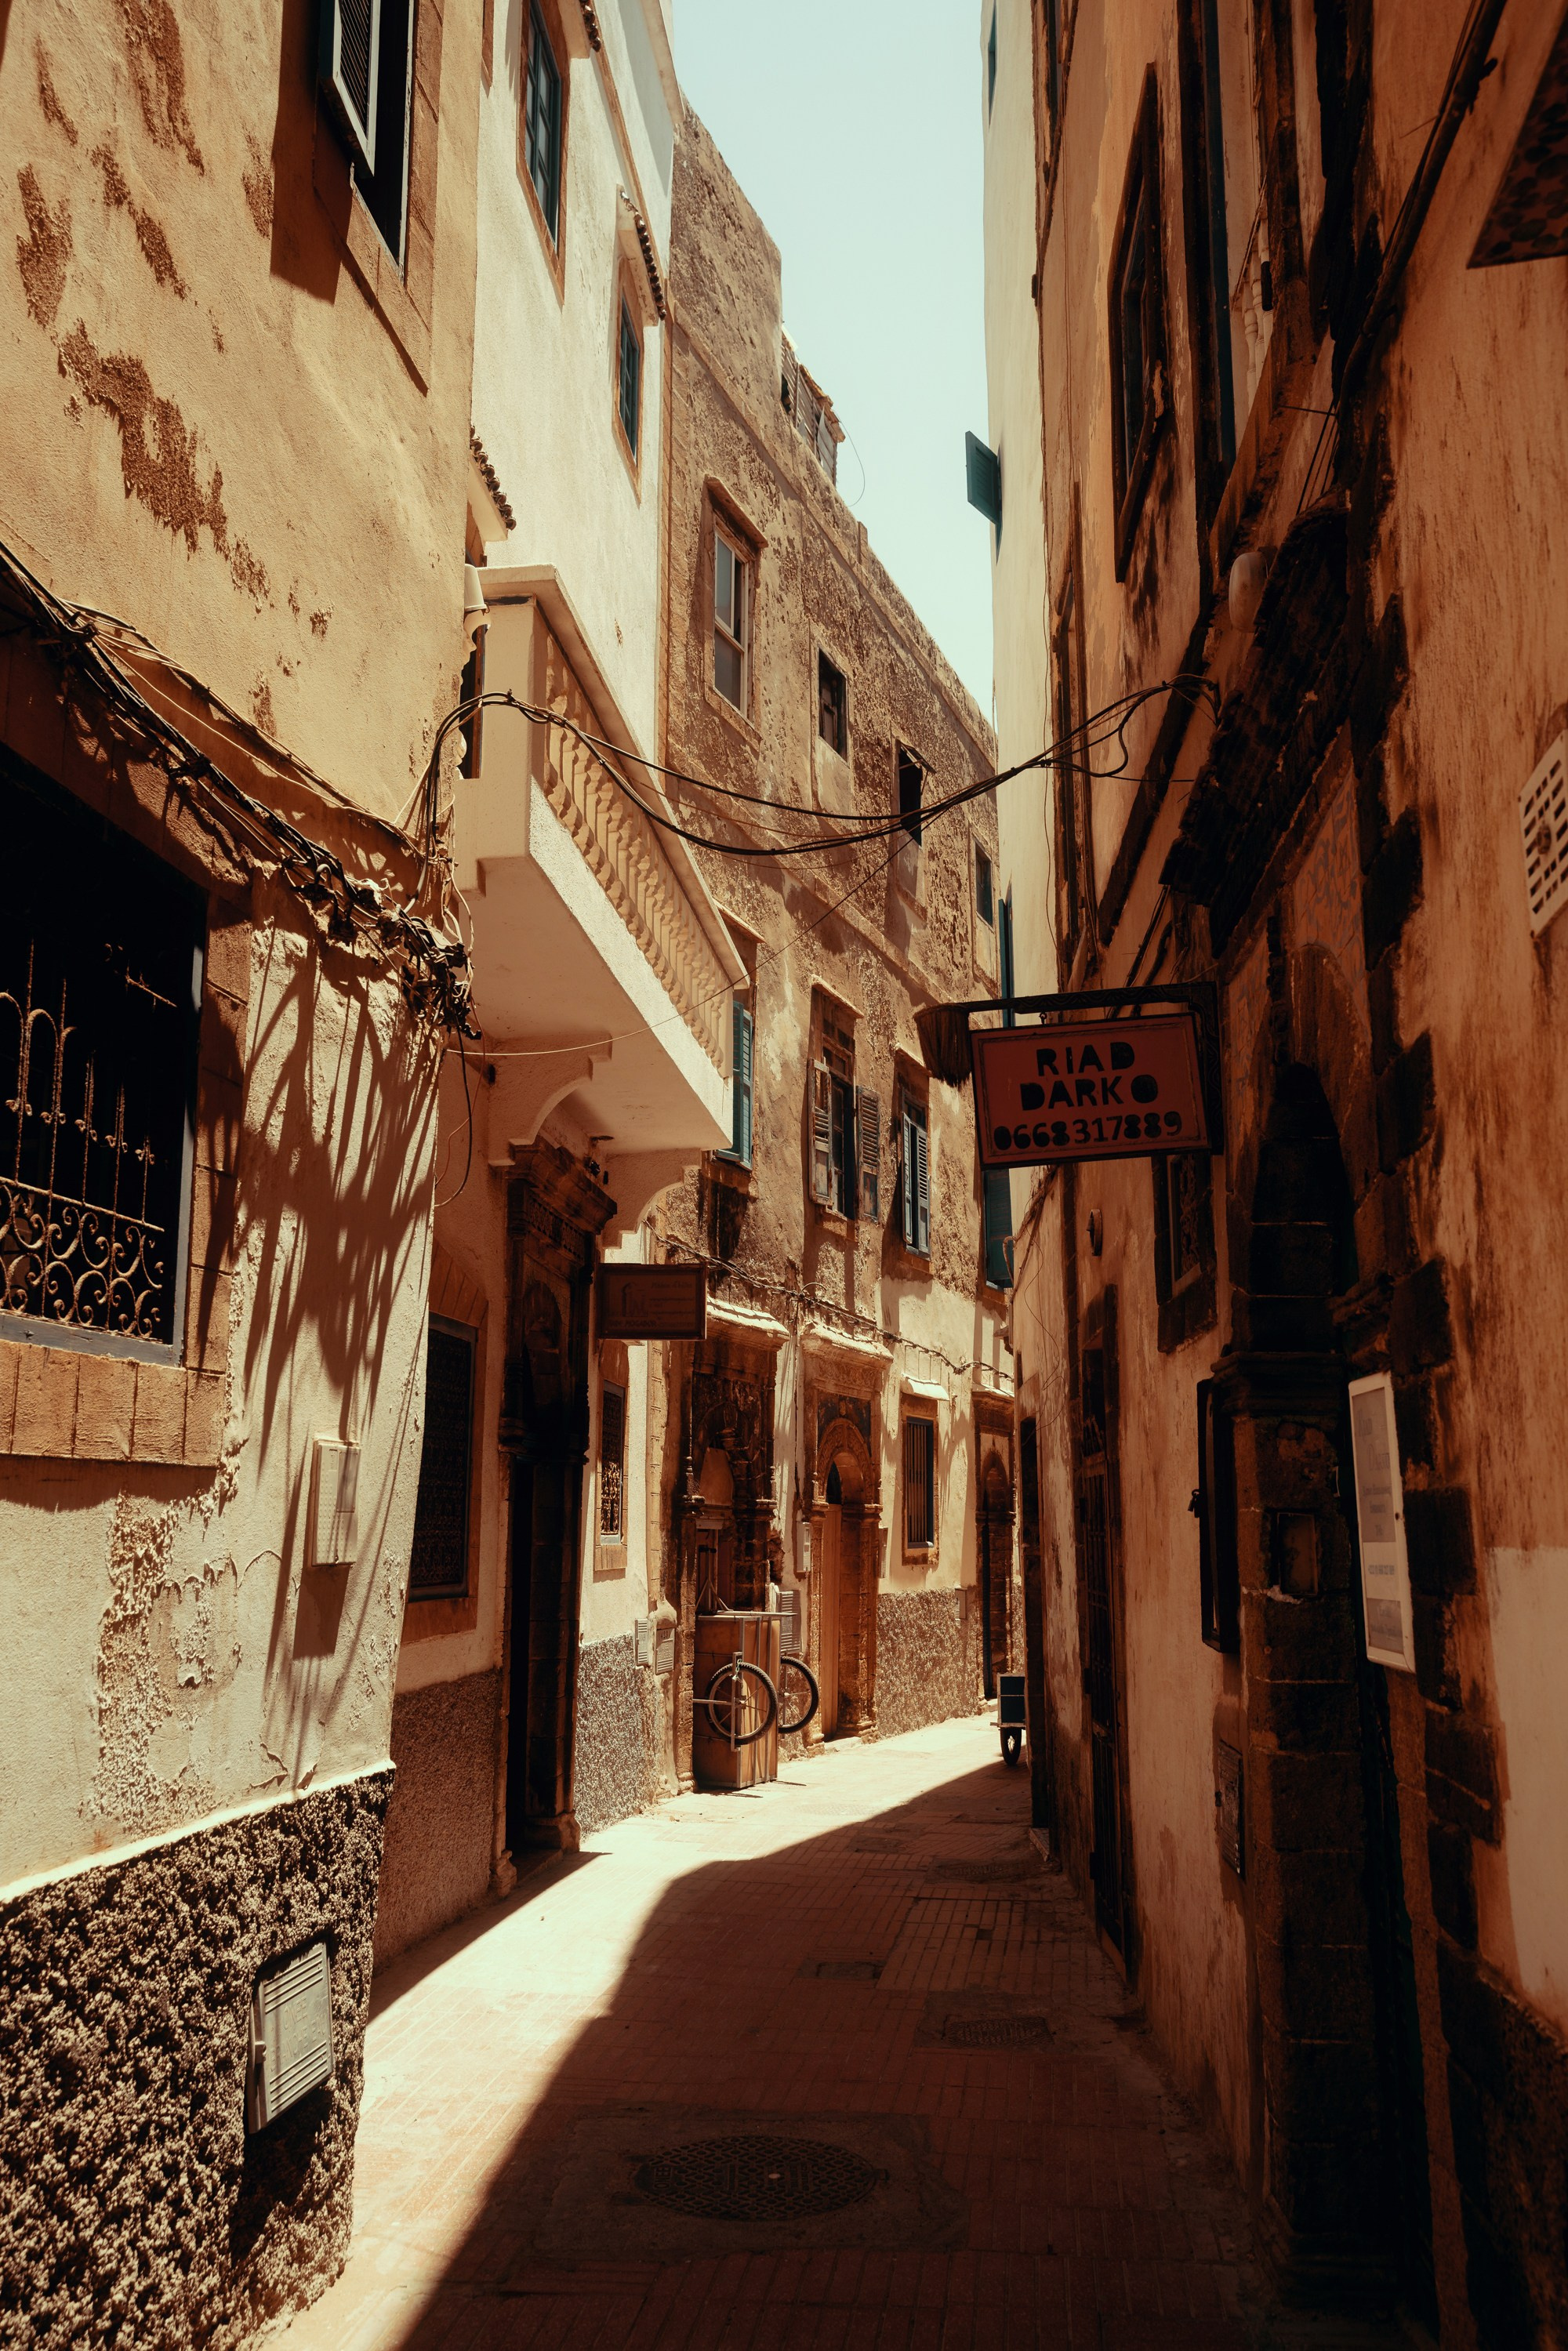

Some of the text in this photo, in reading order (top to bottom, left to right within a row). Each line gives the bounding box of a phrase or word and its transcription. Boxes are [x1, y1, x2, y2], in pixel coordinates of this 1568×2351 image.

[1036, 1041, 1135, 1076] RIAD
[1020, 1074, 1159, 1111] DARKO
[993, 1111, 1182, 1151] 0668317889
[283, 1997, 309, 2031] ONEE
